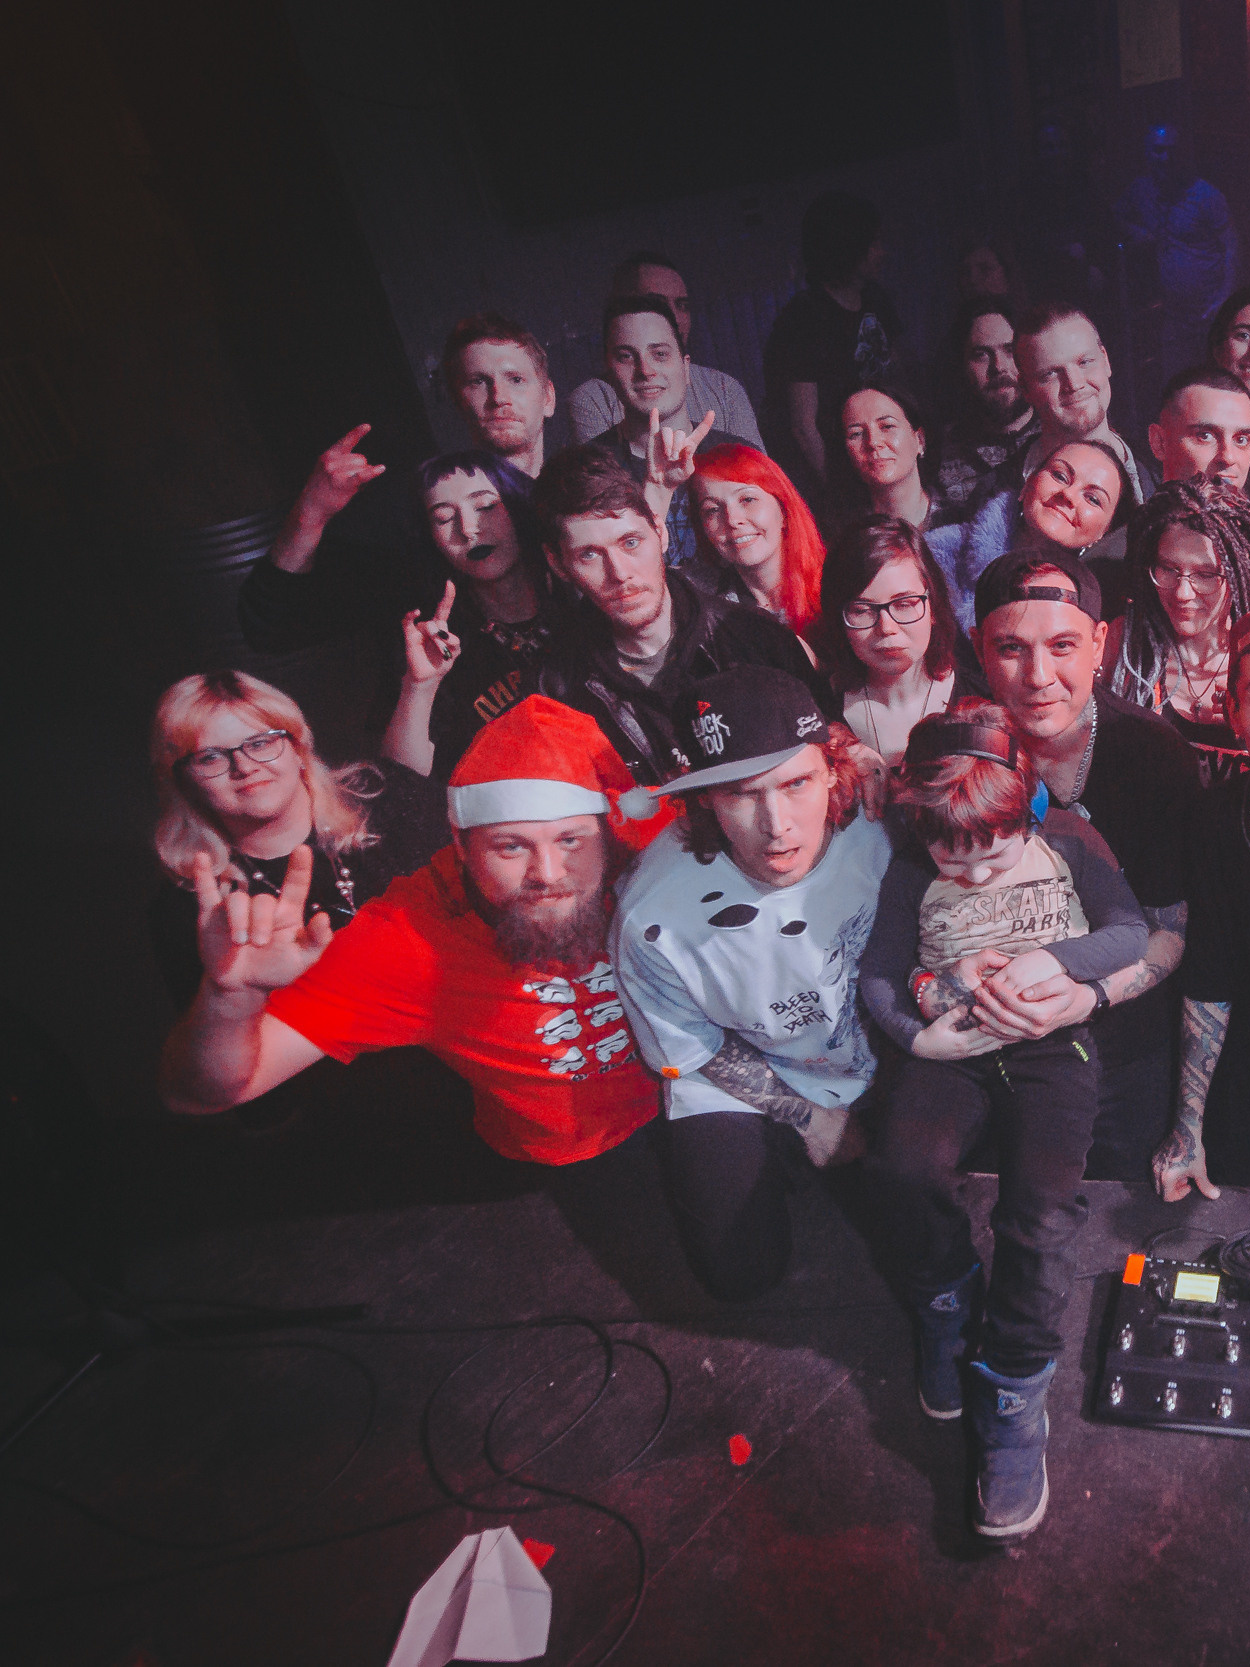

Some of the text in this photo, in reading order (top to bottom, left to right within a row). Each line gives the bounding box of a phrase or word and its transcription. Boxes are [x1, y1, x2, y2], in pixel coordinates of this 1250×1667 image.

[972, 881, 1072, 925] SKATE
[769, 990, 820, 1015] BLEED
[785, 1005, 813, 1019] TO
[783, 1009, 833, 1034] DEATH
